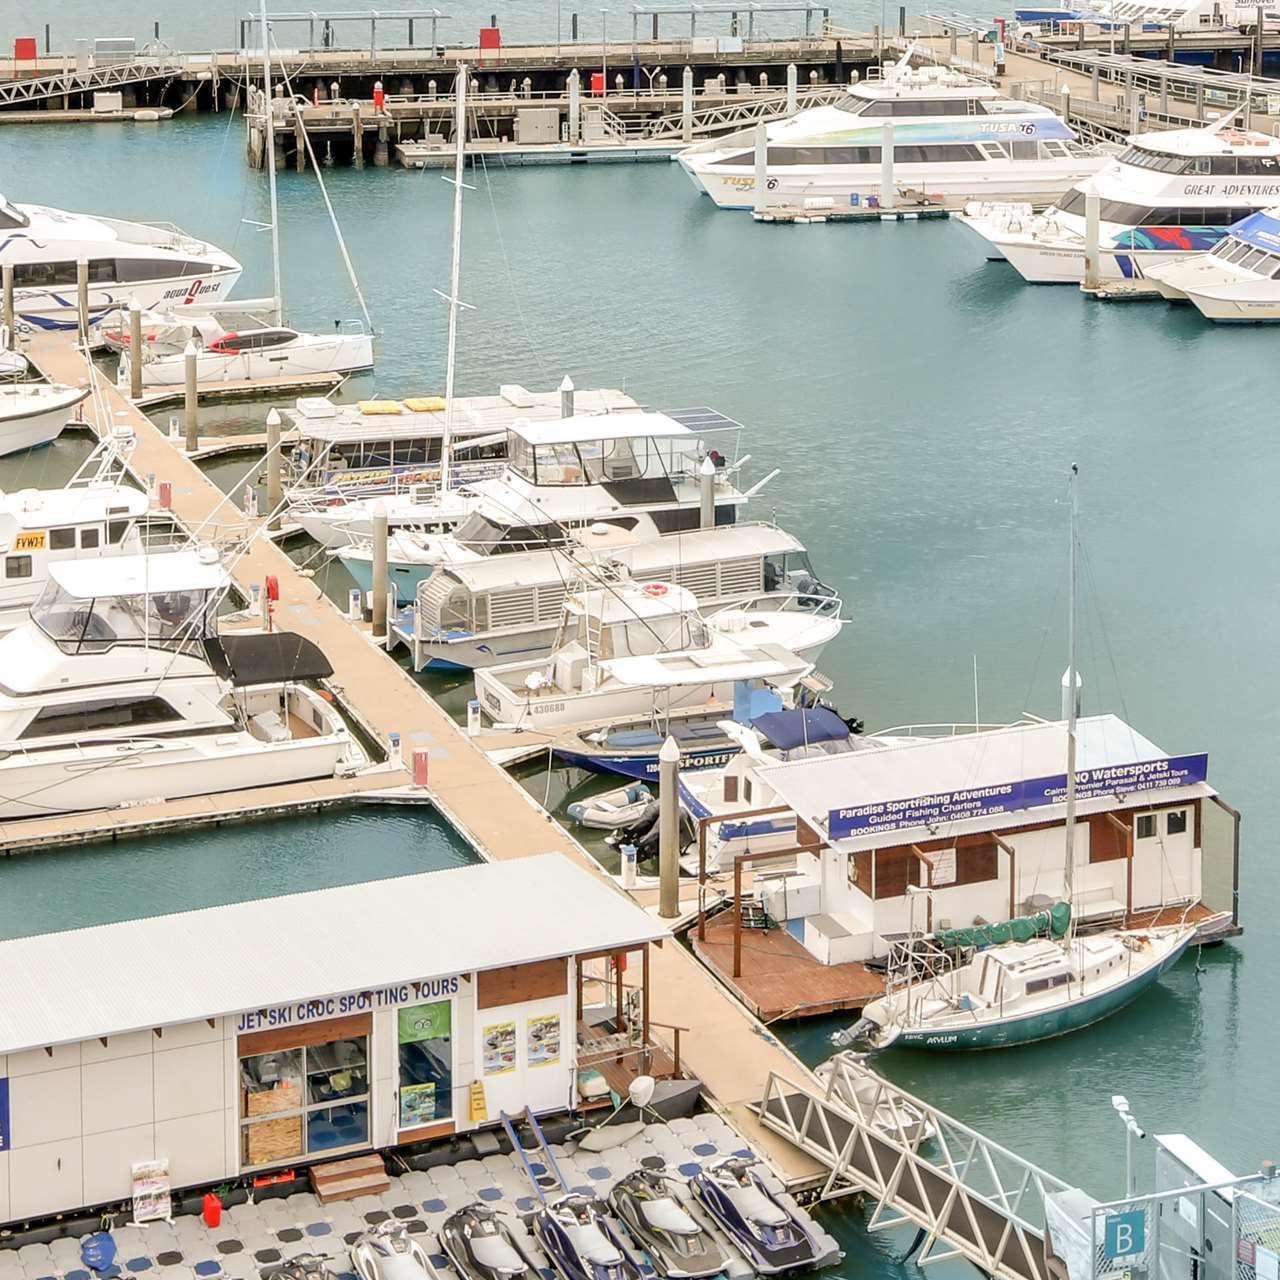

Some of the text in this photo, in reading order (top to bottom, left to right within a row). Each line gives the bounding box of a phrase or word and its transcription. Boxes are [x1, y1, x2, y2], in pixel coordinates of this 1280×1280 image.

[981, 122, 1018, 133] TUSA
[1184, 184, 1280, 195] GREAT ADVENTURES
[1092, 761, 1169, 781] Watersports
[1105, 775, 1138, 787] Parasail
[1147, 771, 1170, 781] Jetski
[1171, 769, 1188, 777] Tours
[839, 785, 1012, 819] Paradise Sportfishing Adventures
[868, 801, 981, 824] Guided Fishing Charters
[850, 823, 896, 837] BOOKINGS
[899, 819, 925, 829] Phone
[238, 977, 459, 1032] JET SKI CROC SPOTTING TOURS
[926, 1035, 958, 1045] ASYLUM
[1115, 1223, 1133, 1254] B
